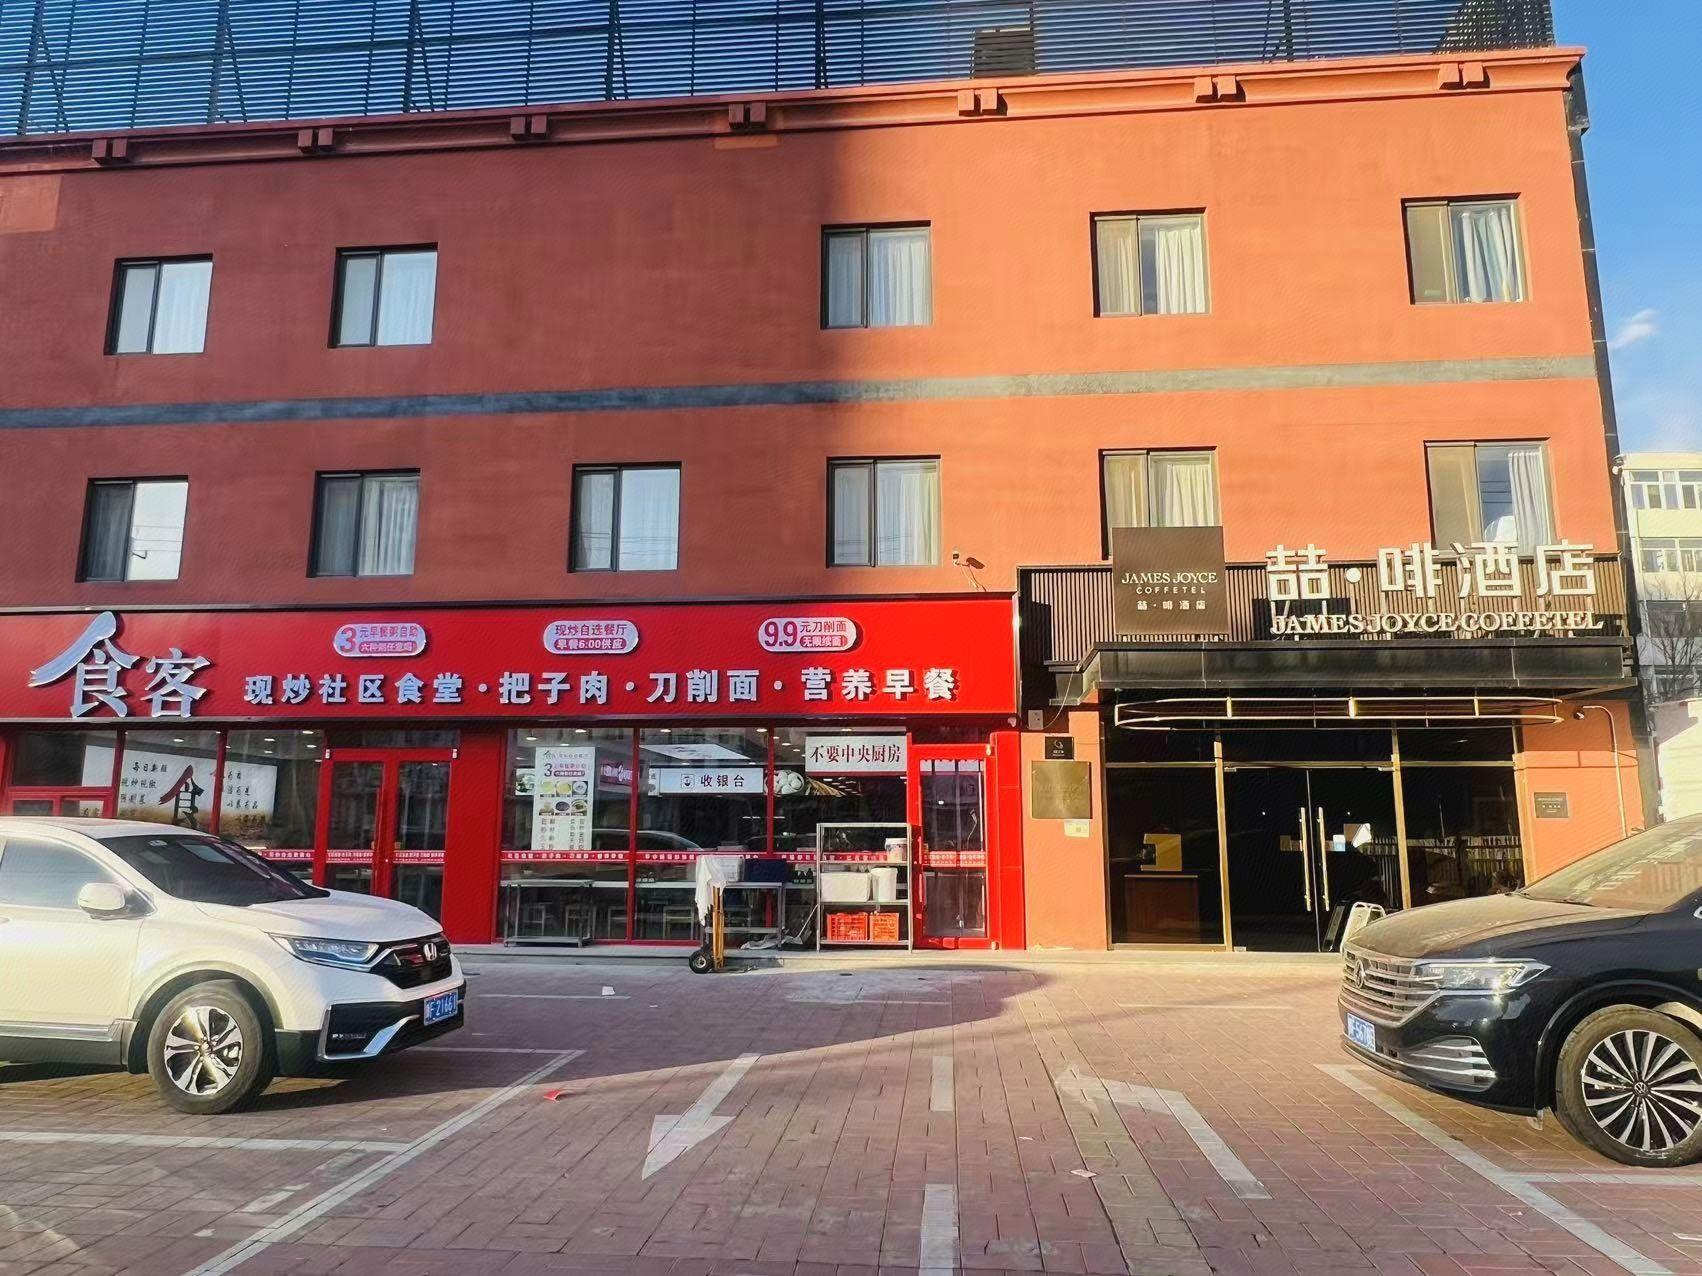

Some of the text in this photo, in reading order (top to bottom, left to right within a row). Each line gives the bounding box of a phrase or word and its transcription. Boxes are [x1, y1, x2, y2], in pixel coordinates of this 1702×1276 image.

[1122, 572, 1217, 584] JAMES JOYCE
[1266, 539, 1598, 601] 喆·啡酒店
[555, 624, 628, 636] 现炒自选餐厅
[764, 620, 847, 647] 9.9 元刀削面
[1270, 611, 1604, 634] JAMES JOYCE COFFETEL
[340, 627, 357, 653] 3
[28, 611, 211, 719] 食客
[810, 743, 901, 764] 不要中央厨房
[700, 774, 746, 788] 收银台
